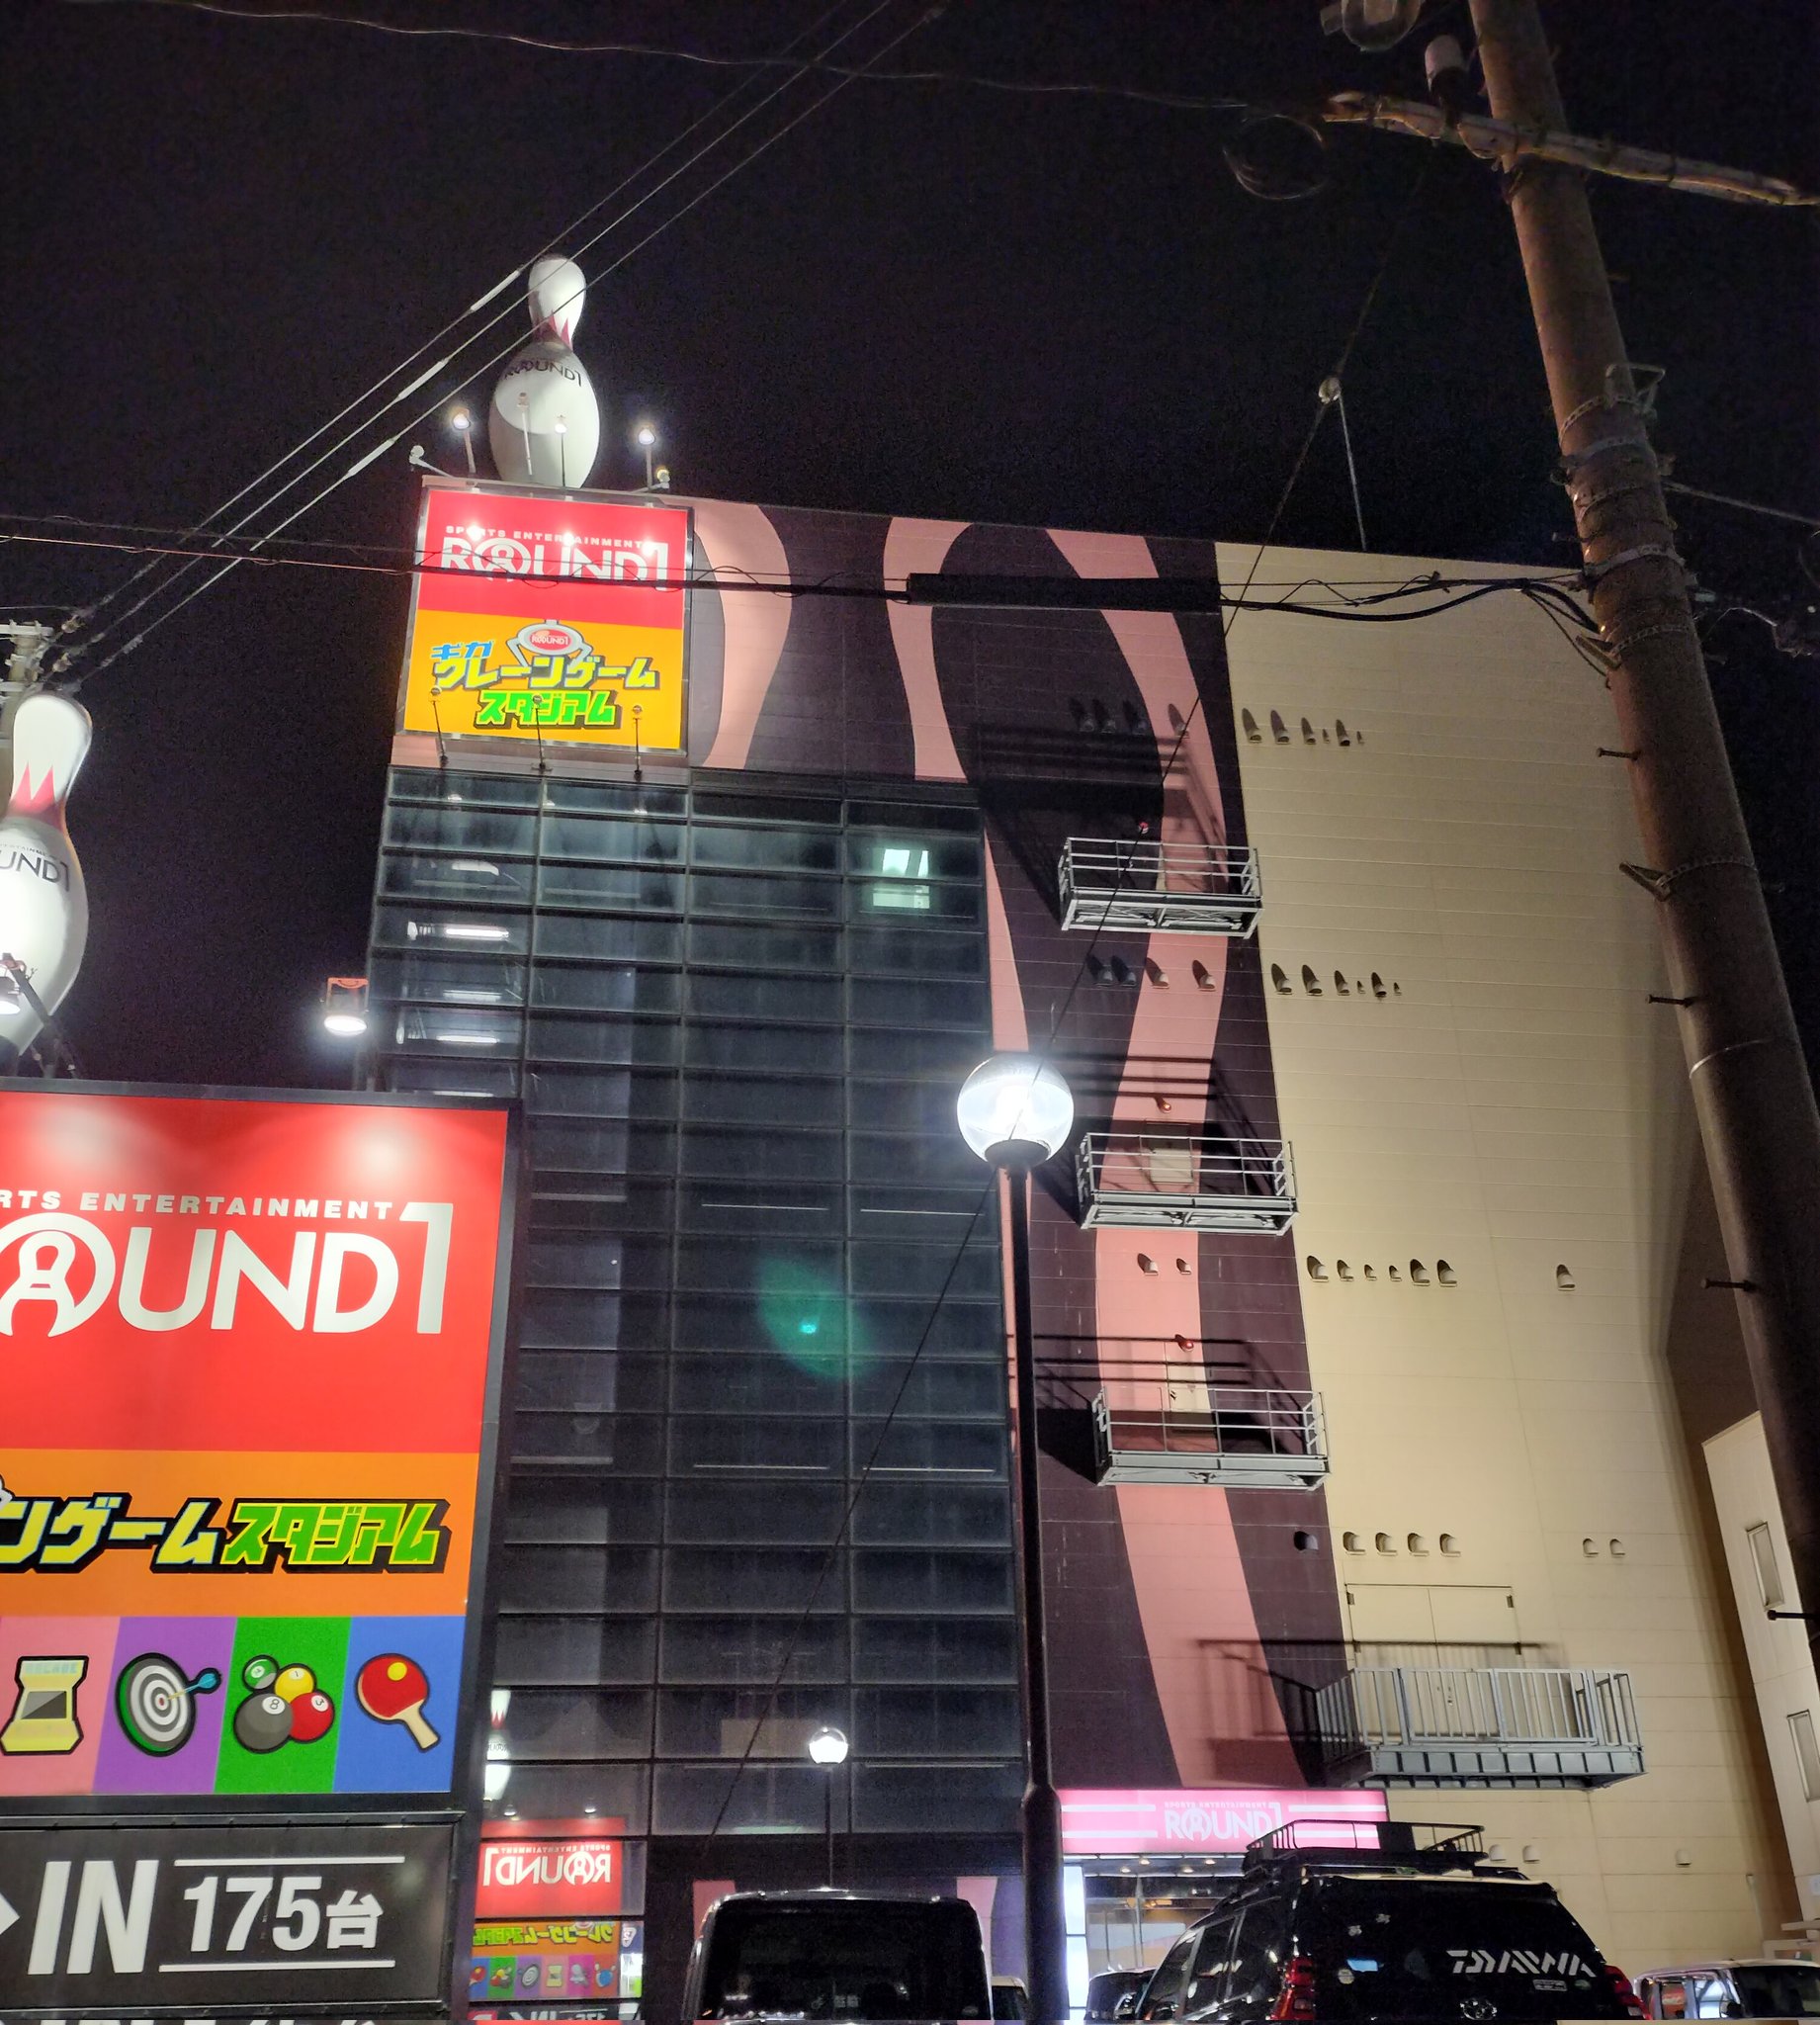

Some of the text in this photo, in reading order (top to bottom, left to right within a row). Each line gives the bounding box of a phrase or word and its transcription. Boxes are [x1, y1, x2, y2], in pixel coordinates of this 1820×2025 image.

[446, 525, 646, 549] SPRTS ENTERAINMENT
[440, 536, 668, 591] ROUND1
[431, 641, 495, 660] ギガ
[433, 655, 659, 690] クレーンゲーム
[475, 689, 620, 728] スタジアム
[80, 1191, 393, 1220] ENTERTAINMENT
[28, 1860, 384, 1975] IN 175台
[1446, 1950, 1597, 1978] DAIWA
